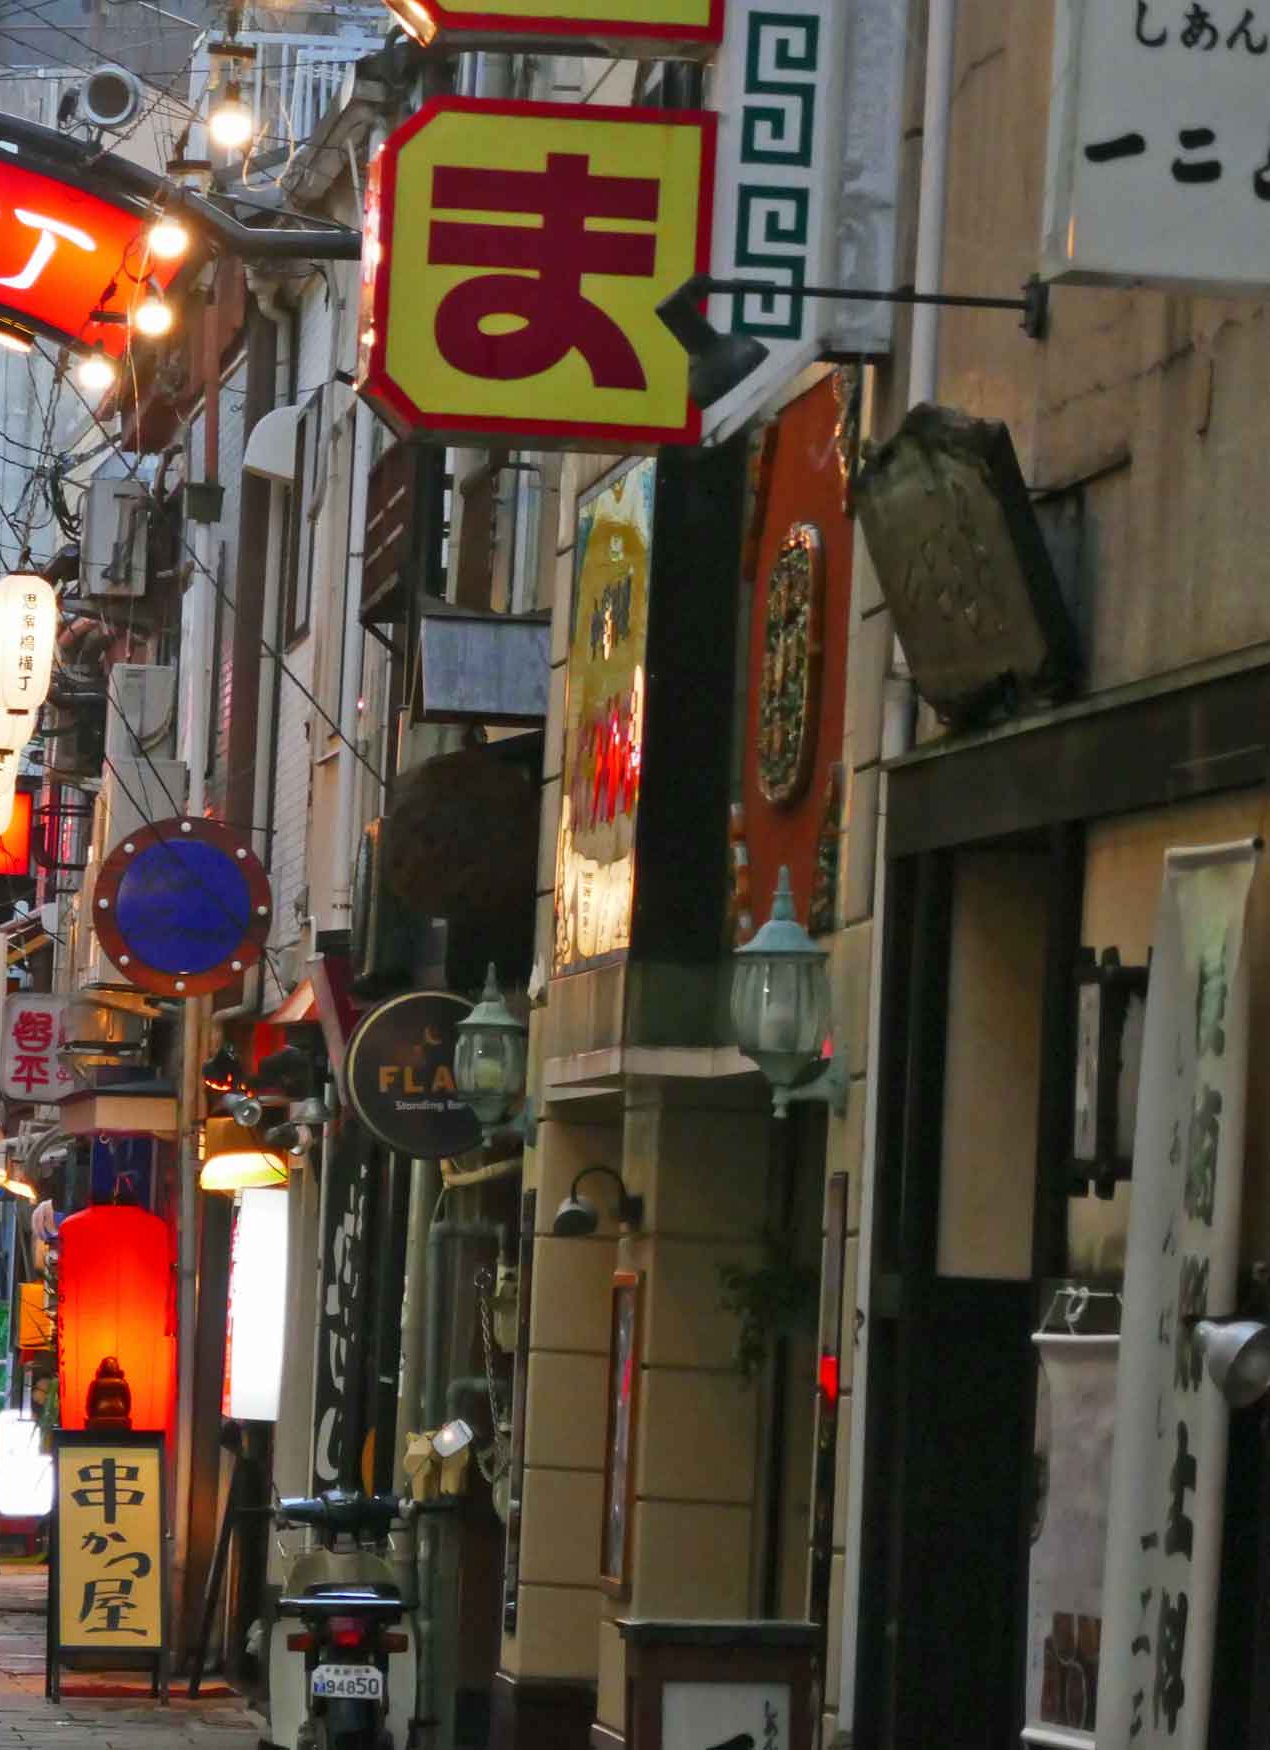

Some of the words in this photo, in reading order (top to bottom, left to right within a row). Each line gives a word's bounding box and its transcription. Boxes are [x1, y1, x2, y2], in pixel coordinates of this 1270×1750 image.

[428, 153, 660, 391] ま
[378, 1065, 456, 1094] FLA
[70, 1457, 152, 1638] 串かつ屋
